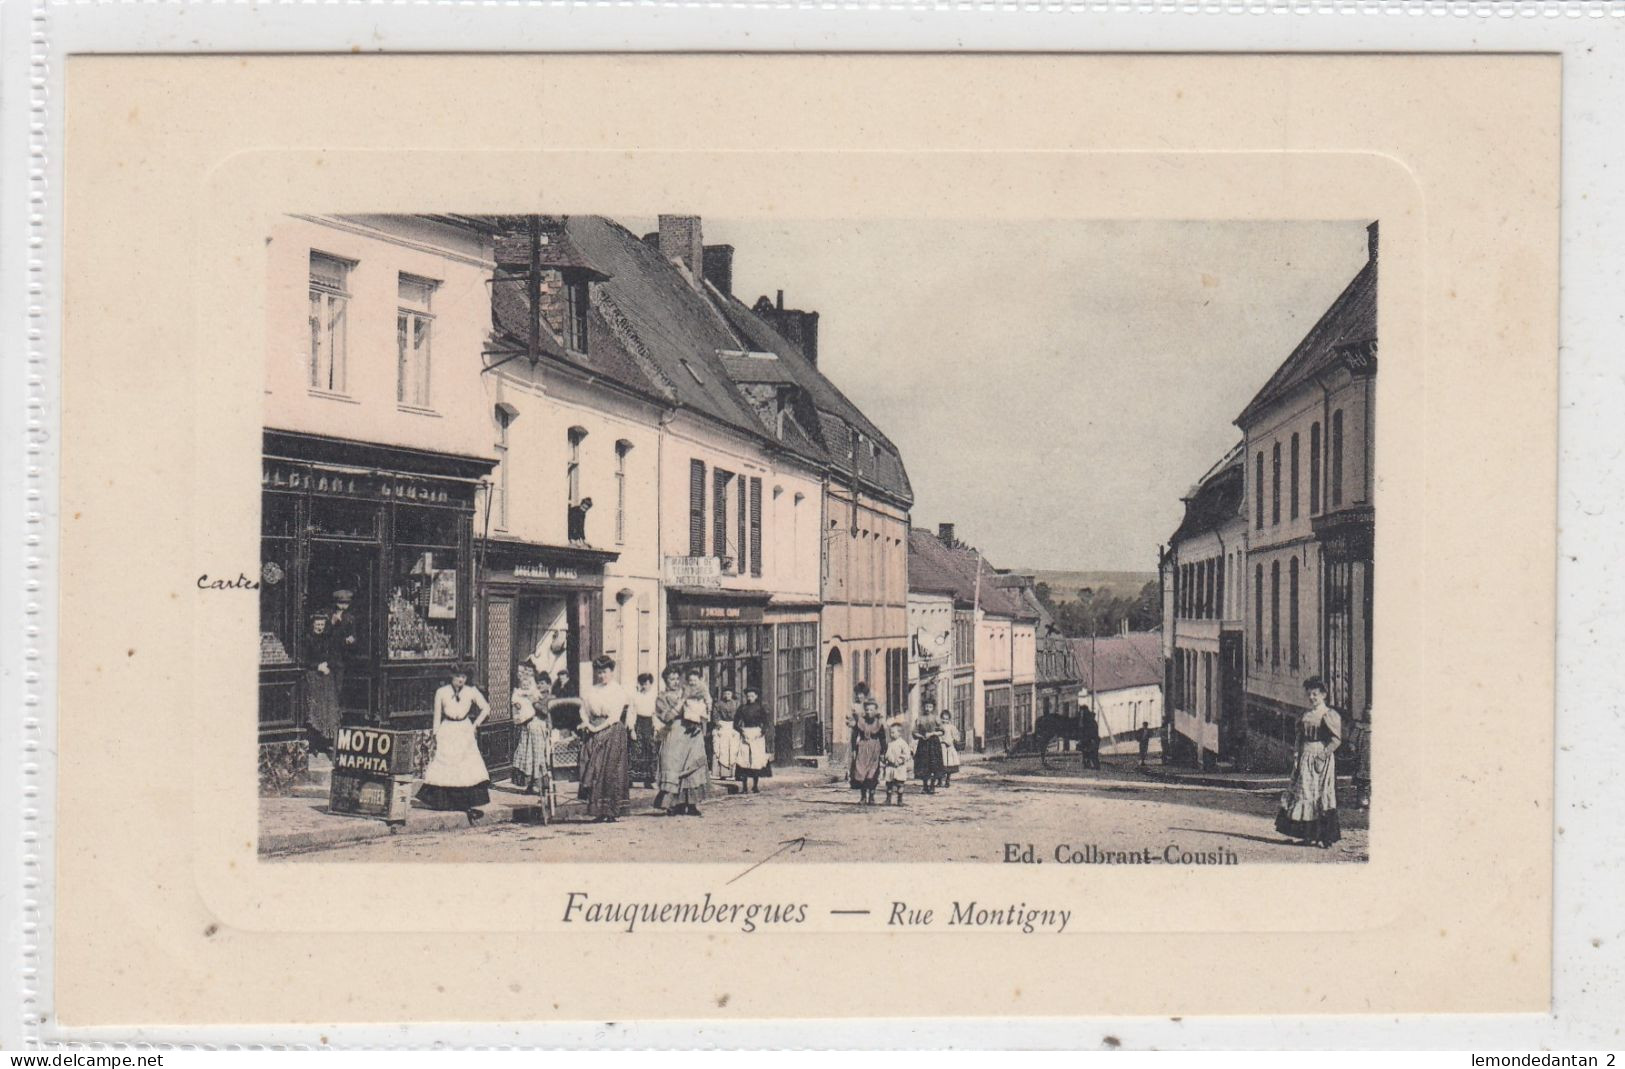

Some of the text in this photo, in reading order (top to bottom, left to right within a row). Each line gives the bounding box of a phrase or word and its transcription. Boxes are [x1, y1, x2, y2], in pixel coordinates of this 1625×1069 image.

[337, 728, 391, 755] MOTO
[337, 753, 388, 772] NAPHTA
[1002, 843, 1239, 866] Ed. Colbrant-Cousin
[561, 891, 809, 934] Fauquembergues
[887, 900, 934, 926] Rue
[948, 900, 1072, 934] Montigny
